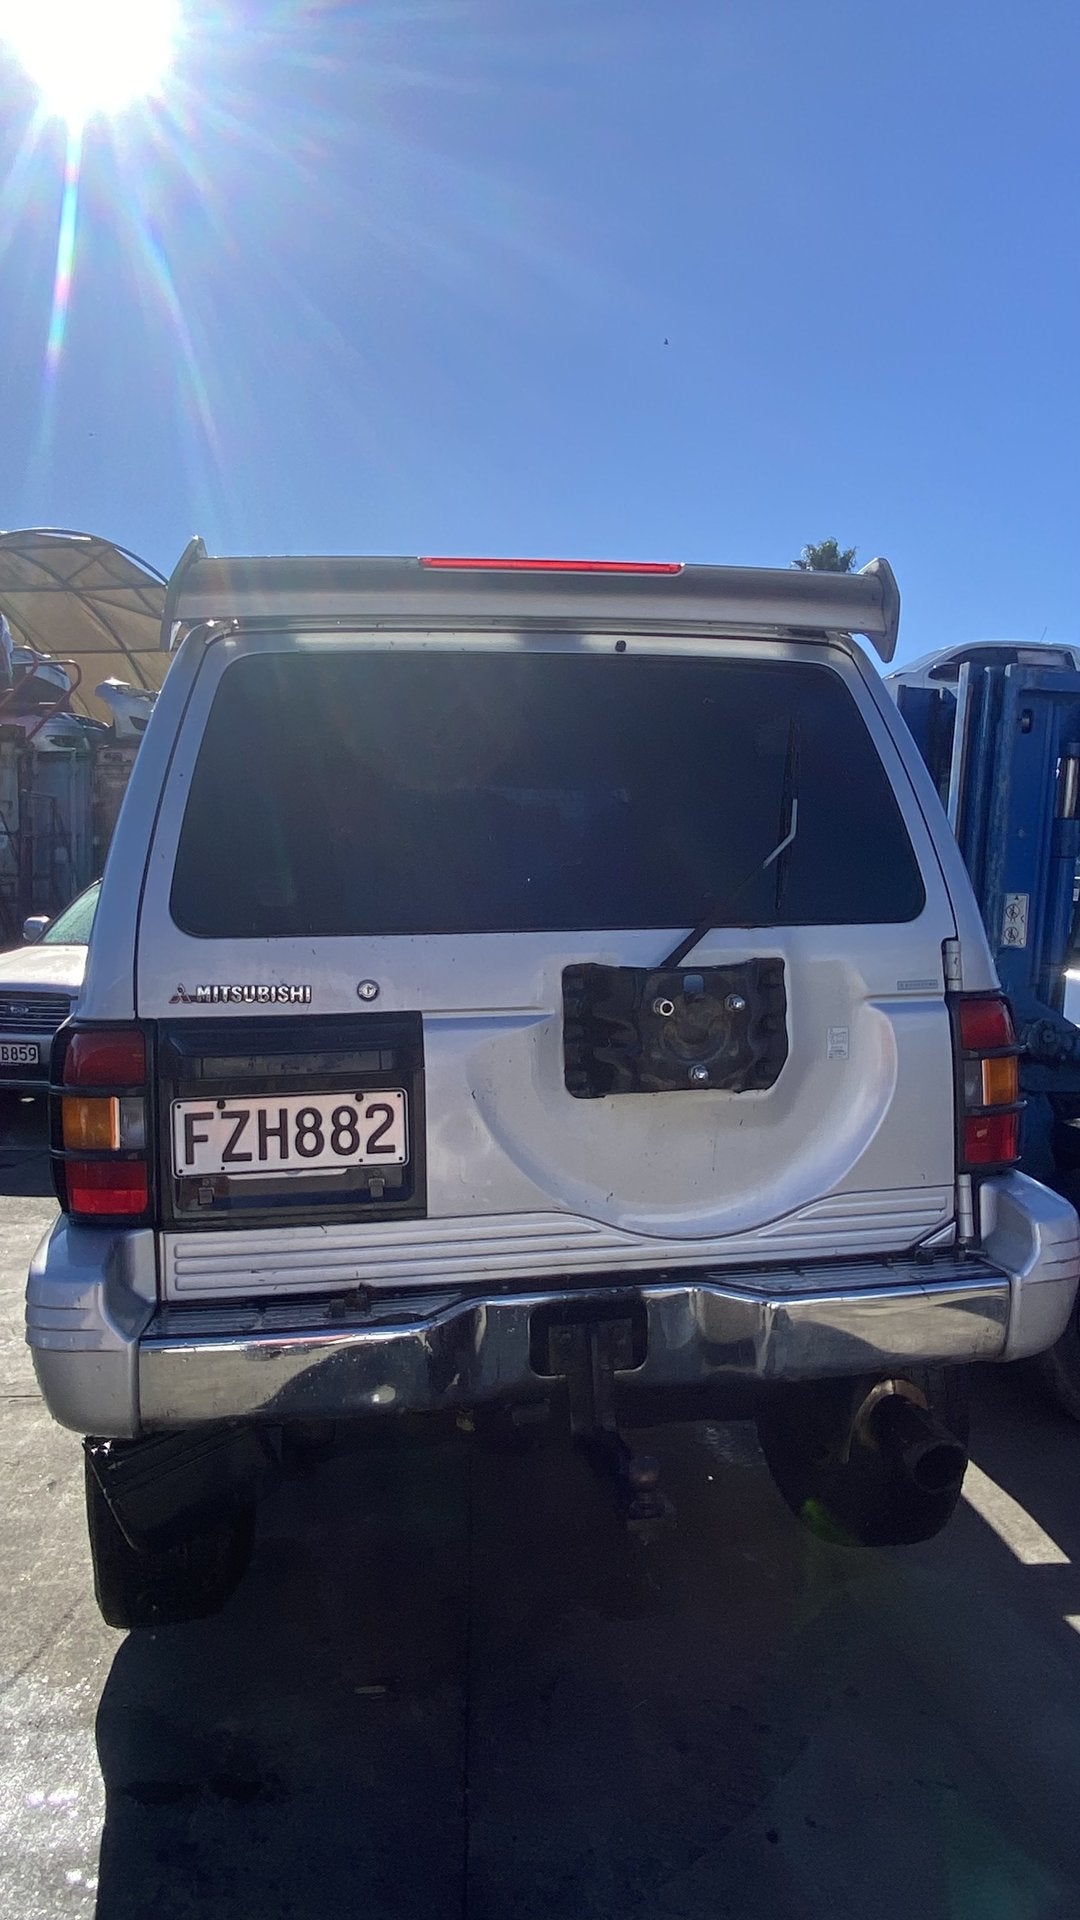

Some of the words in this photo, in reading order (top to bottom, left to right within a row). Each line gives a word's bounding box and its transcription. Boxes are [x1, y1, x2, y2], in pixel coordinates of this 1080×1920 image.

[196, 984, 312, 1003] MITSUBISHI
[1, 1046, 37, 1061] B859
[184, 1103, 396, 1165] FZH882
